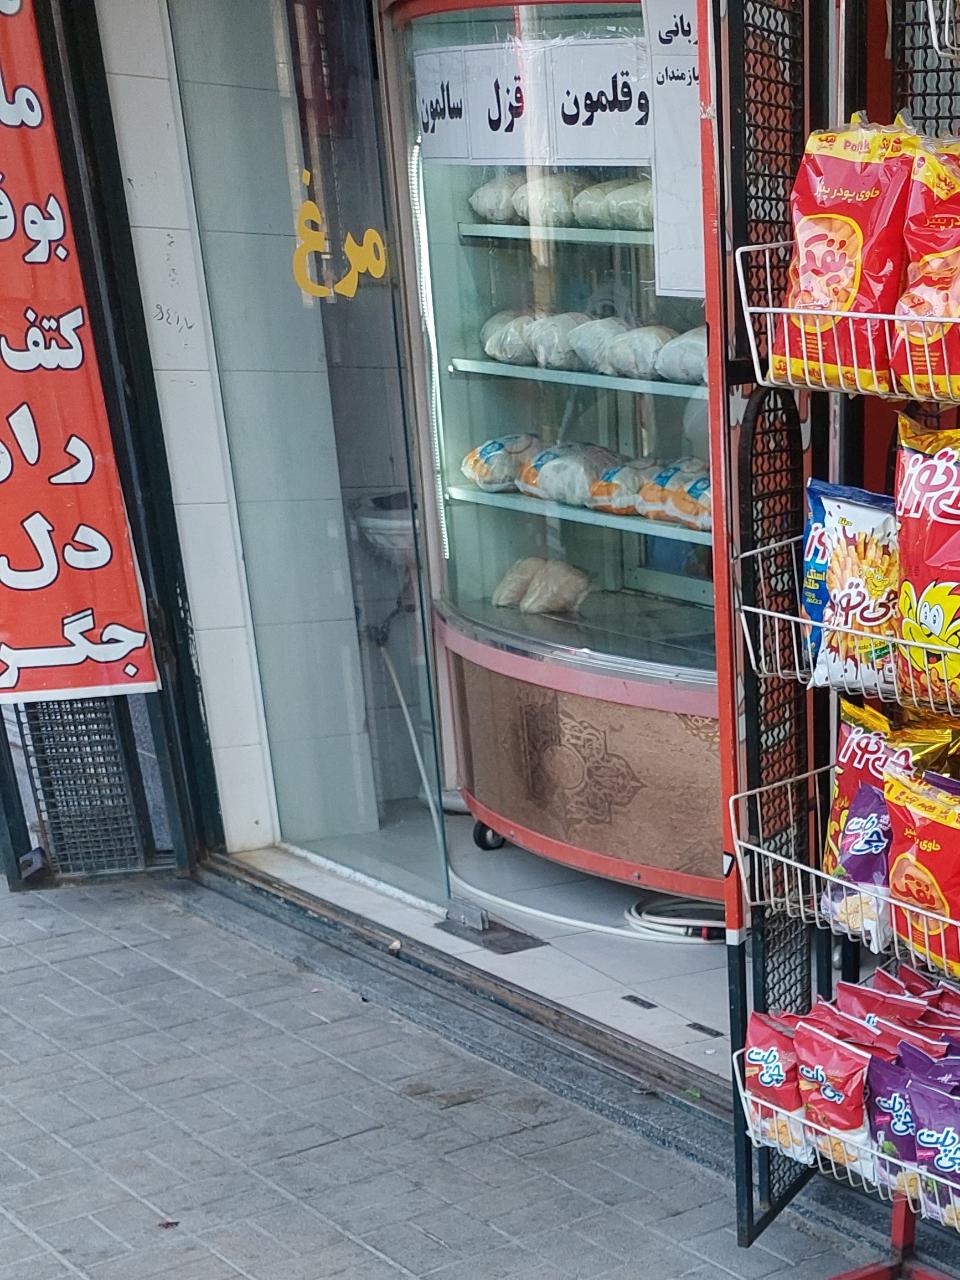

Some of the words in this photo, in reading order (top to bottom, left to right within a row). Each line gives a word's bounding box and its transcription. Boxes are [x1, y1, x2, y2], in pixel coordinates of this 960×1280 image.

[420, 80, 463, 133] سالمون
[487, 76, 525, 132] قزل
[561, 71, 650, 126] وقلمون
[832, 187, 856, 203] پودر
[856, 186, 880, 200] حاوی
[293, 169, 386, 298] مرغ
[0, 306, 84, 371] کتف
[0, 511, 112, 590] دل
[920, 839, 941, 852] حاوی
